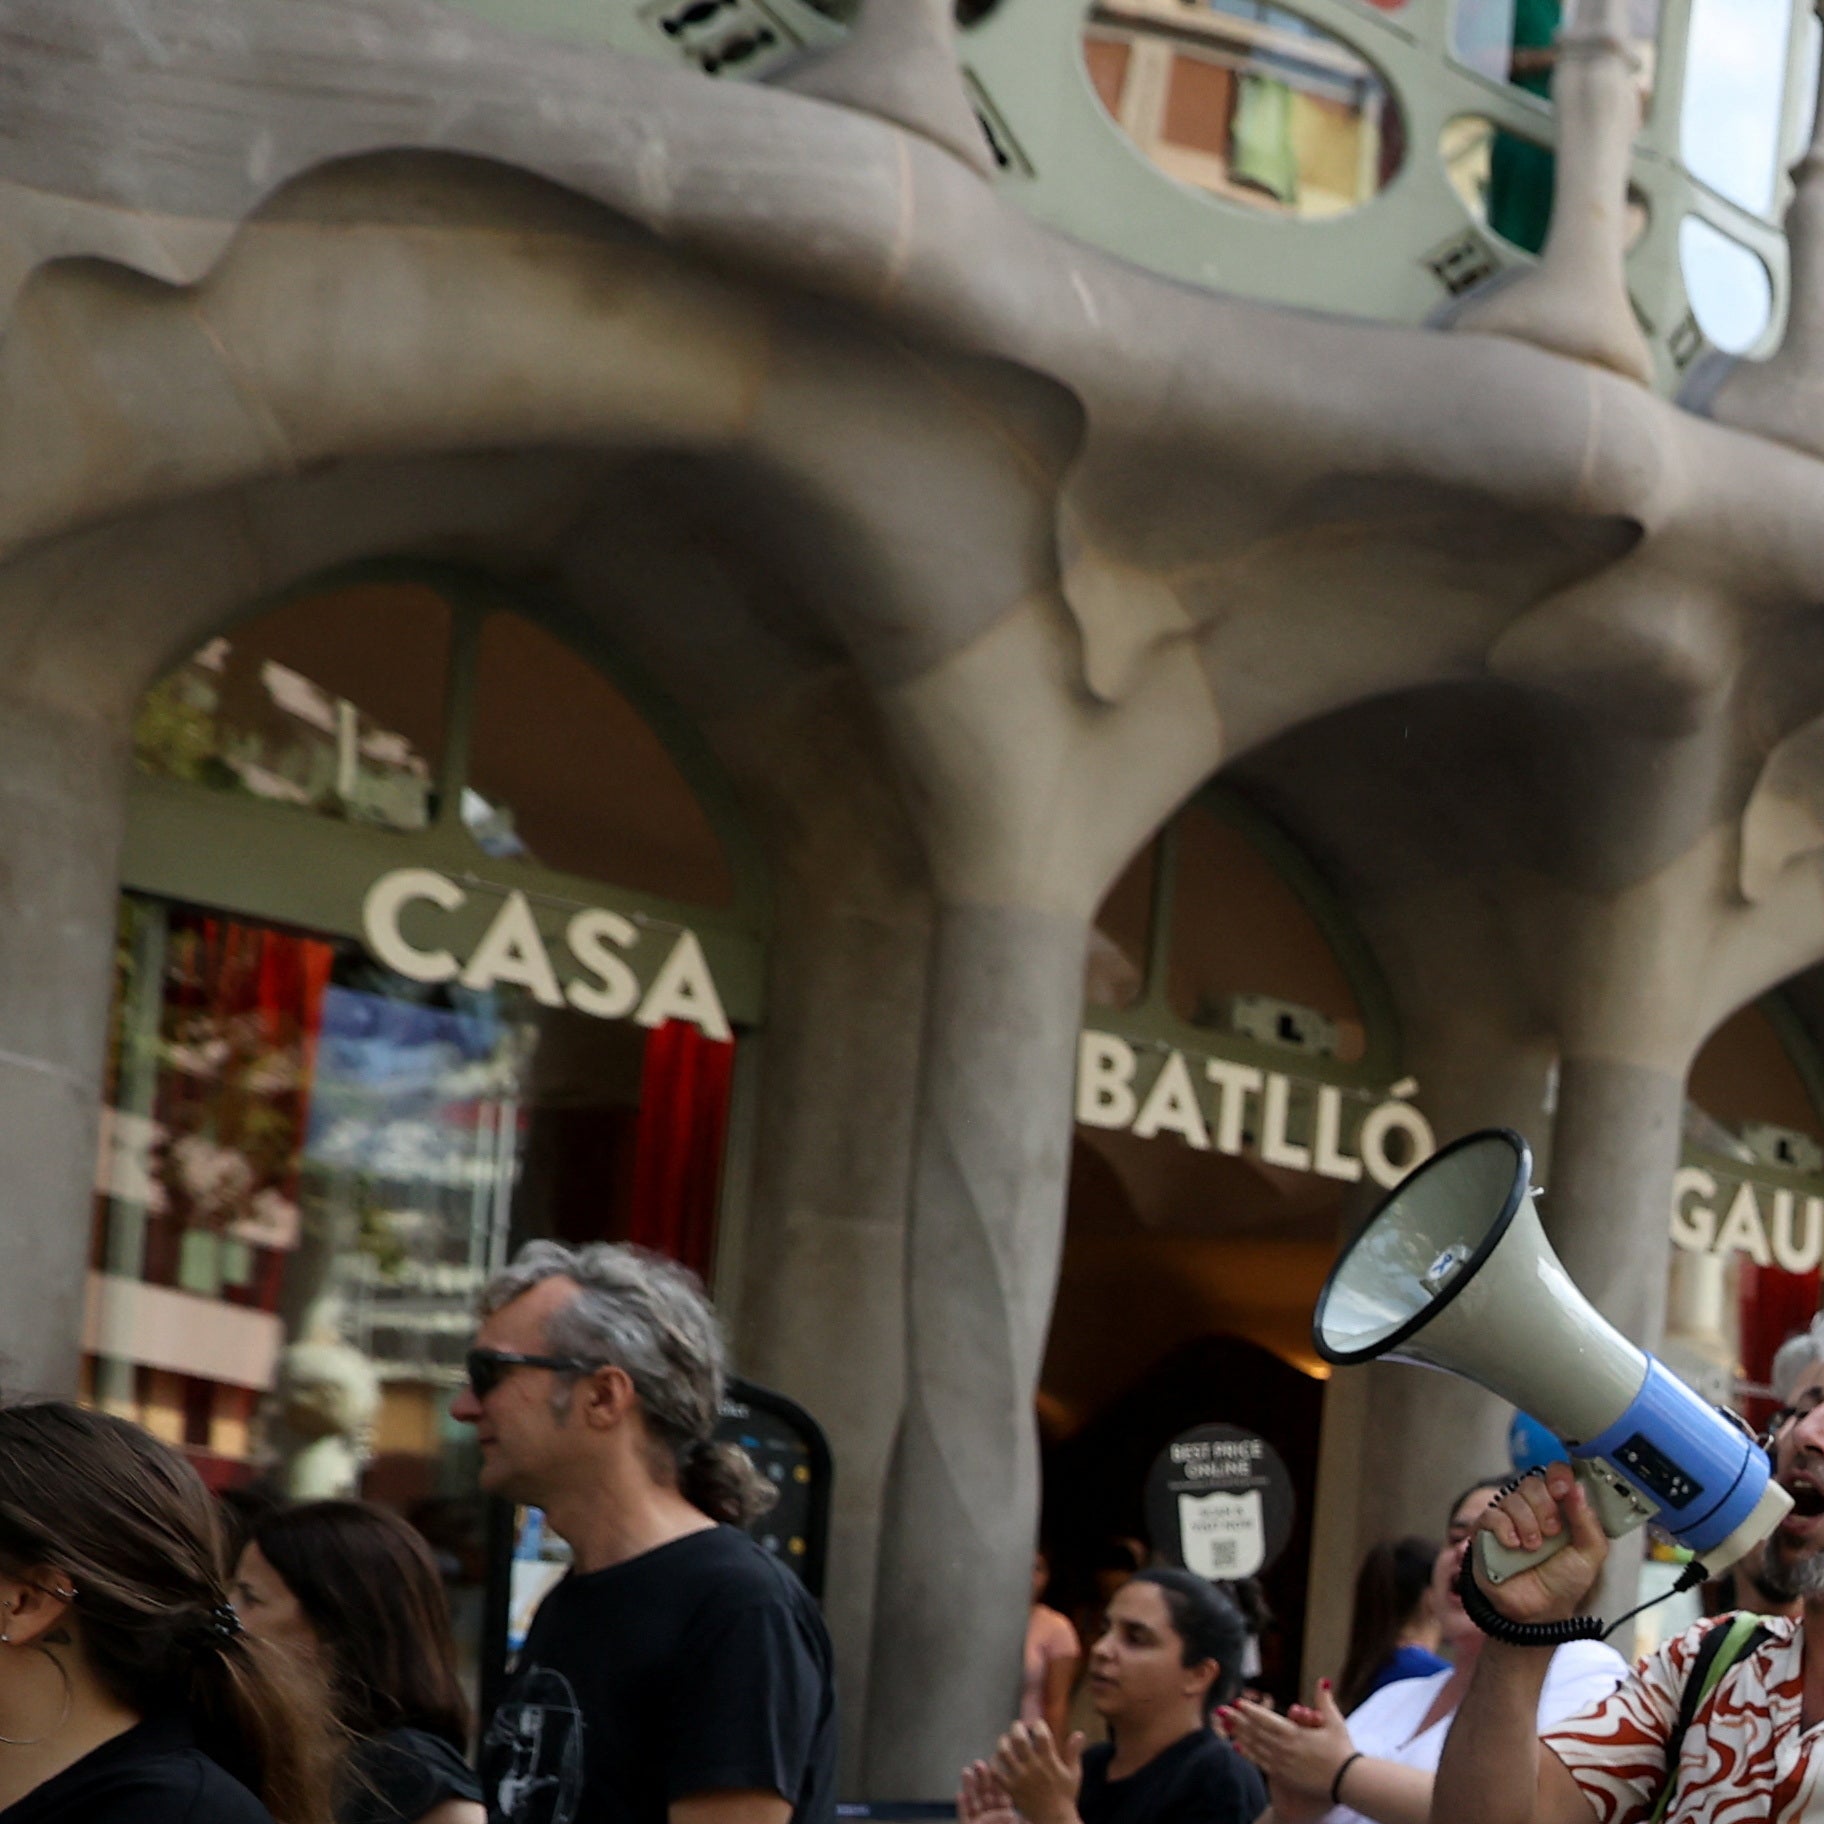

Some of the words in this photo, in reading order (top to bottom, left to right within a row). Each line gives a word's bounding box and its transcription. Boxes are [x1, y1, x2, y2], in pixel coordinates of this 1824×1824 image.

[363, 868, 734, 1043] CASA
[1076, 1030, 1436, 1191] BATLLÓ
[1184, 1461, 1251, 1479] ONLINE
